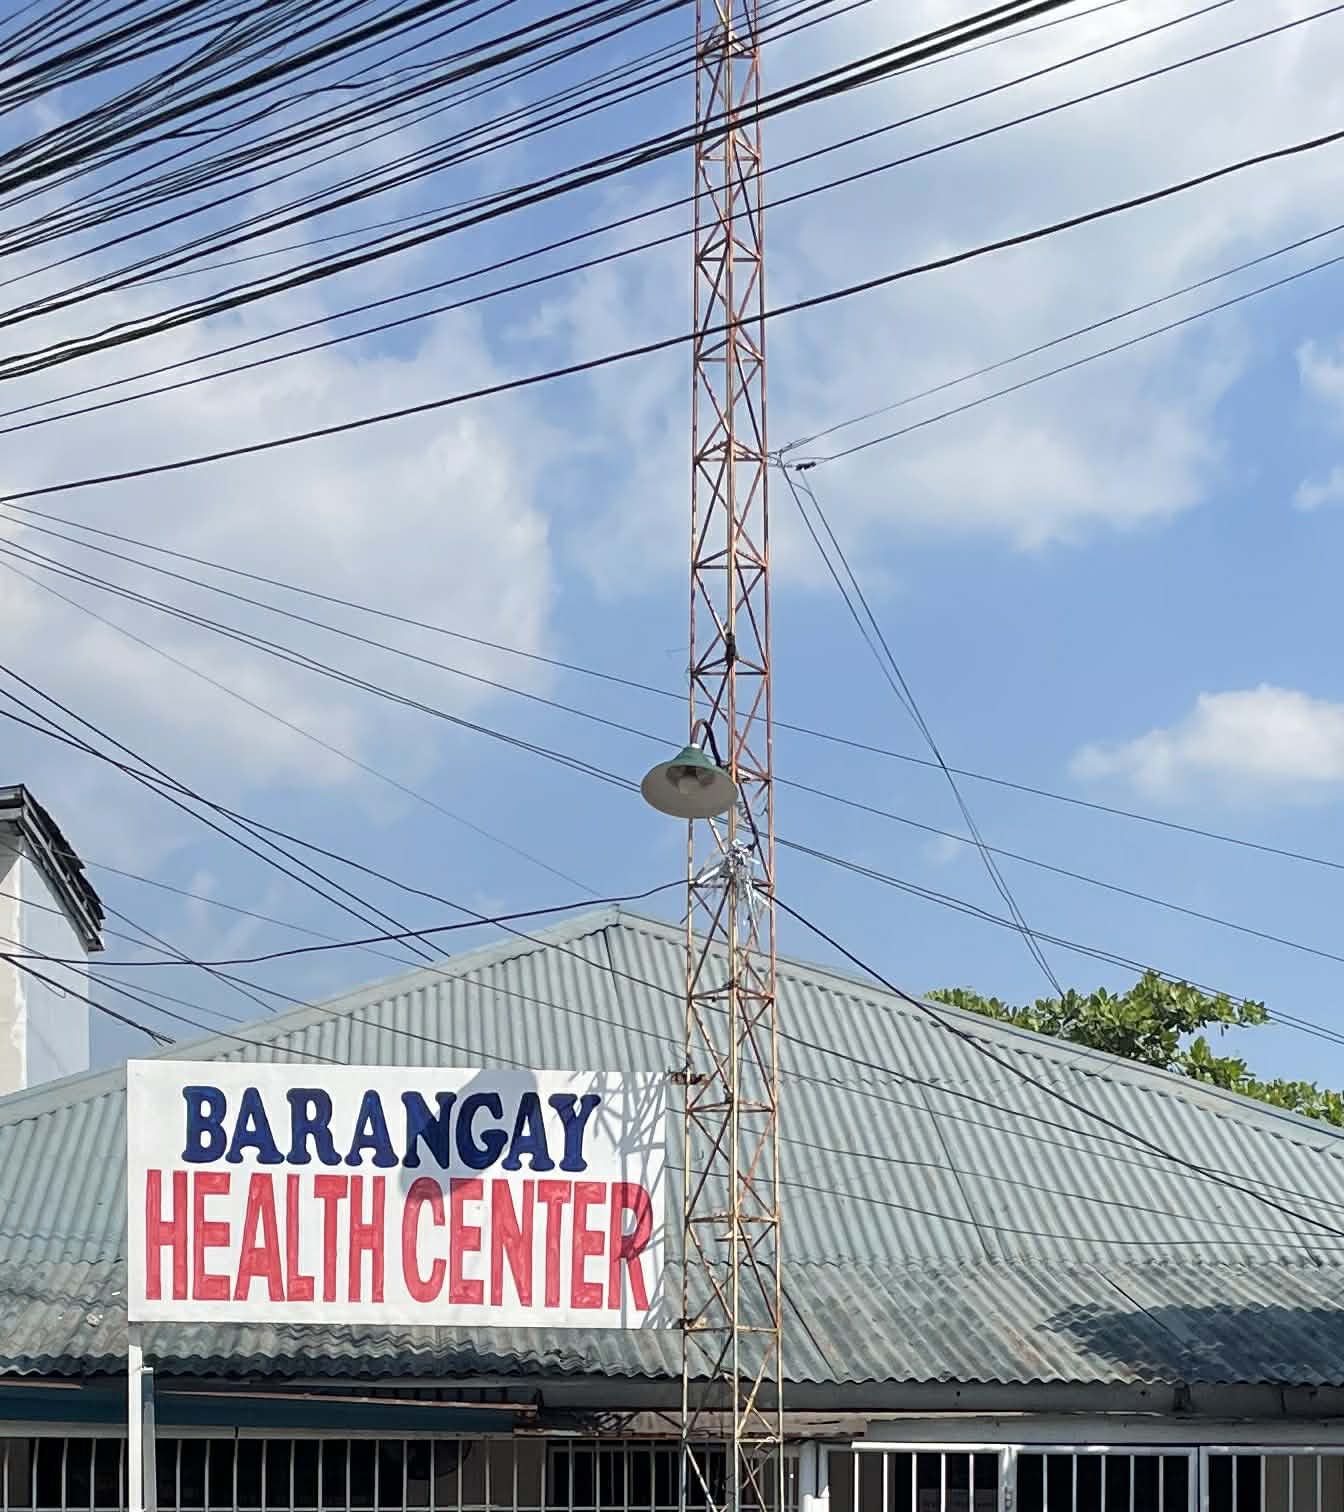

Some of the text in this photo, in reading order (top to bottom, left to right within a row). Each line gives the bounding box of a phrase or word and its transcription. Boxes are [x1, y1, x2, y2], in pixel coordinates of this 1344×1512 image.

[181, 1085, 602, 1173] BARANGAY
[144, 1168, 654, 1312] HEALTH CENTER
